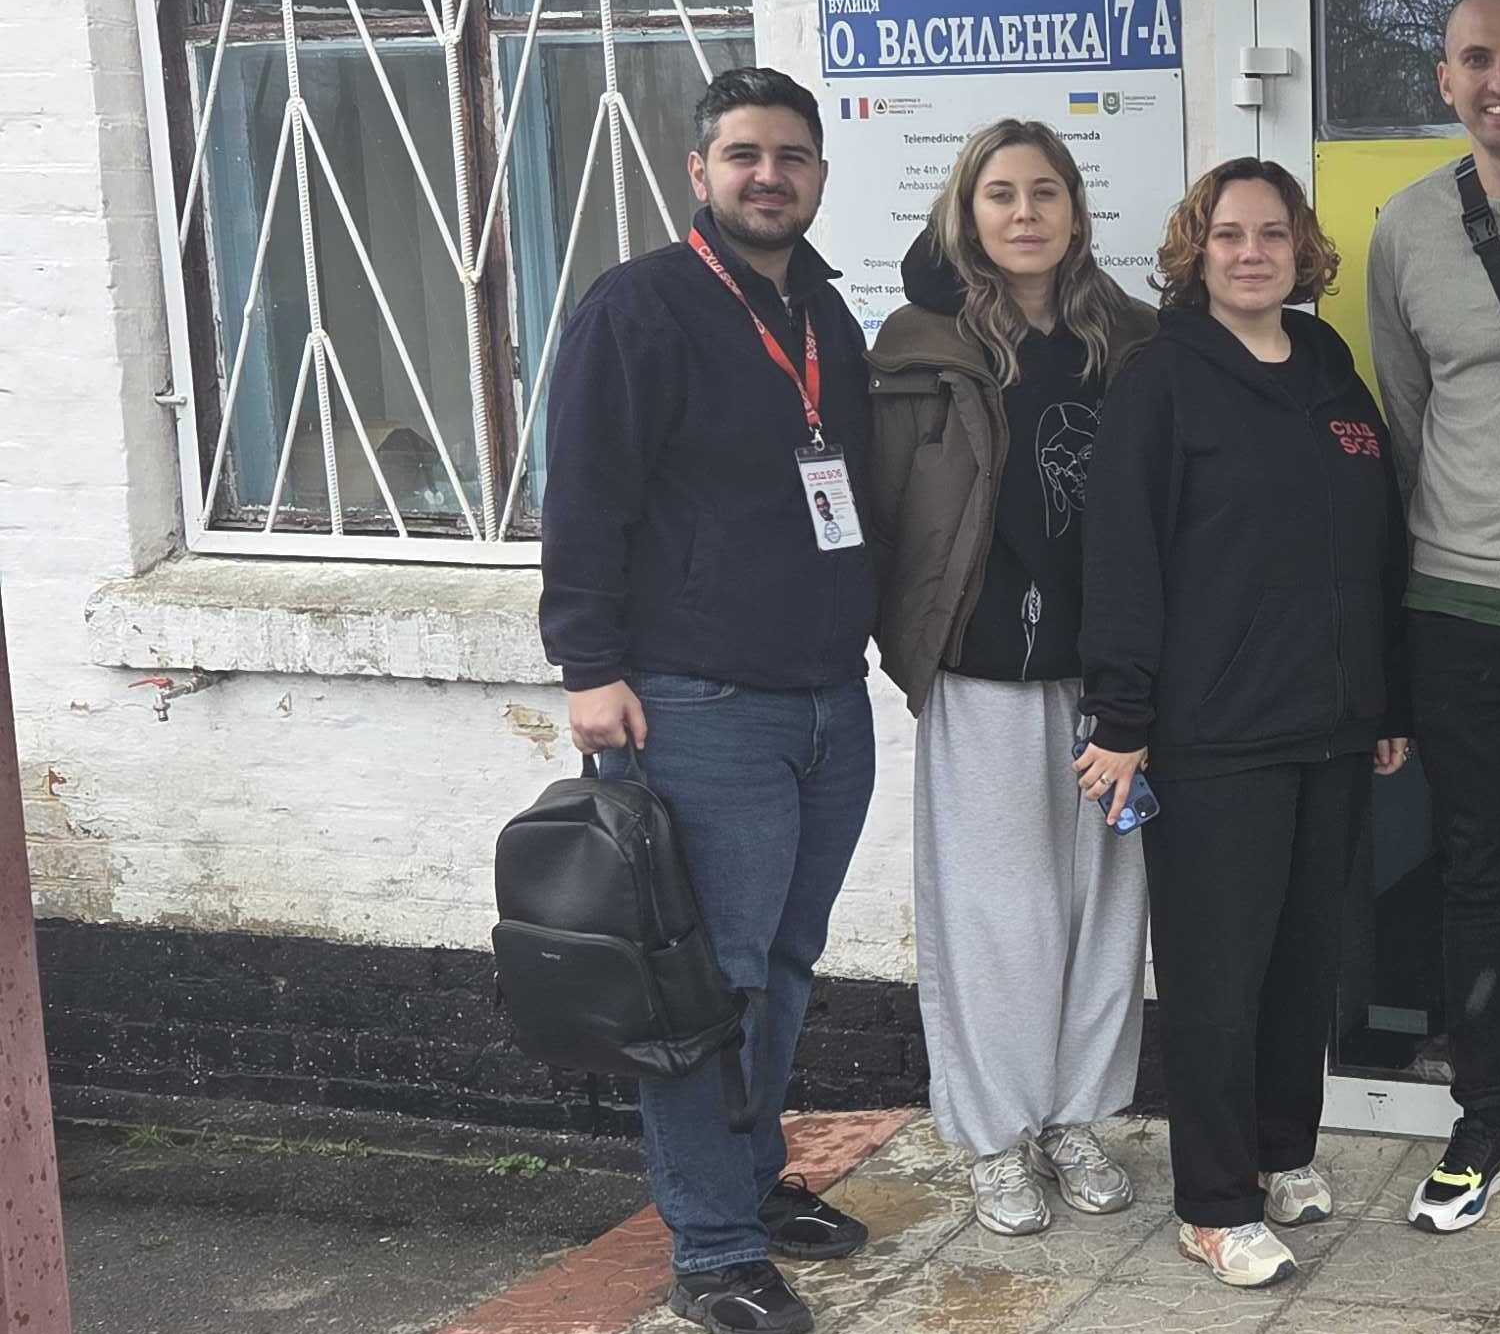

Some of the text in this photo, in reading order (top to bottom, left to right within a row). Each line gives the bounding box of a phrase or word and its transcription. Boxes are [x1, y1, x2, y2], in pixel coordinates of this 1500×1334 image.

[830, 12, 1105, 67] О. ВАСИЛЕНКА
[904, 134, 964, 144] Telemedicine
[906, 165, 921, 174] the
[924, 165, 939, 174] 4th
[899, 181, 945, 190] Ambassad
[850, 285, 882, 294] Project
